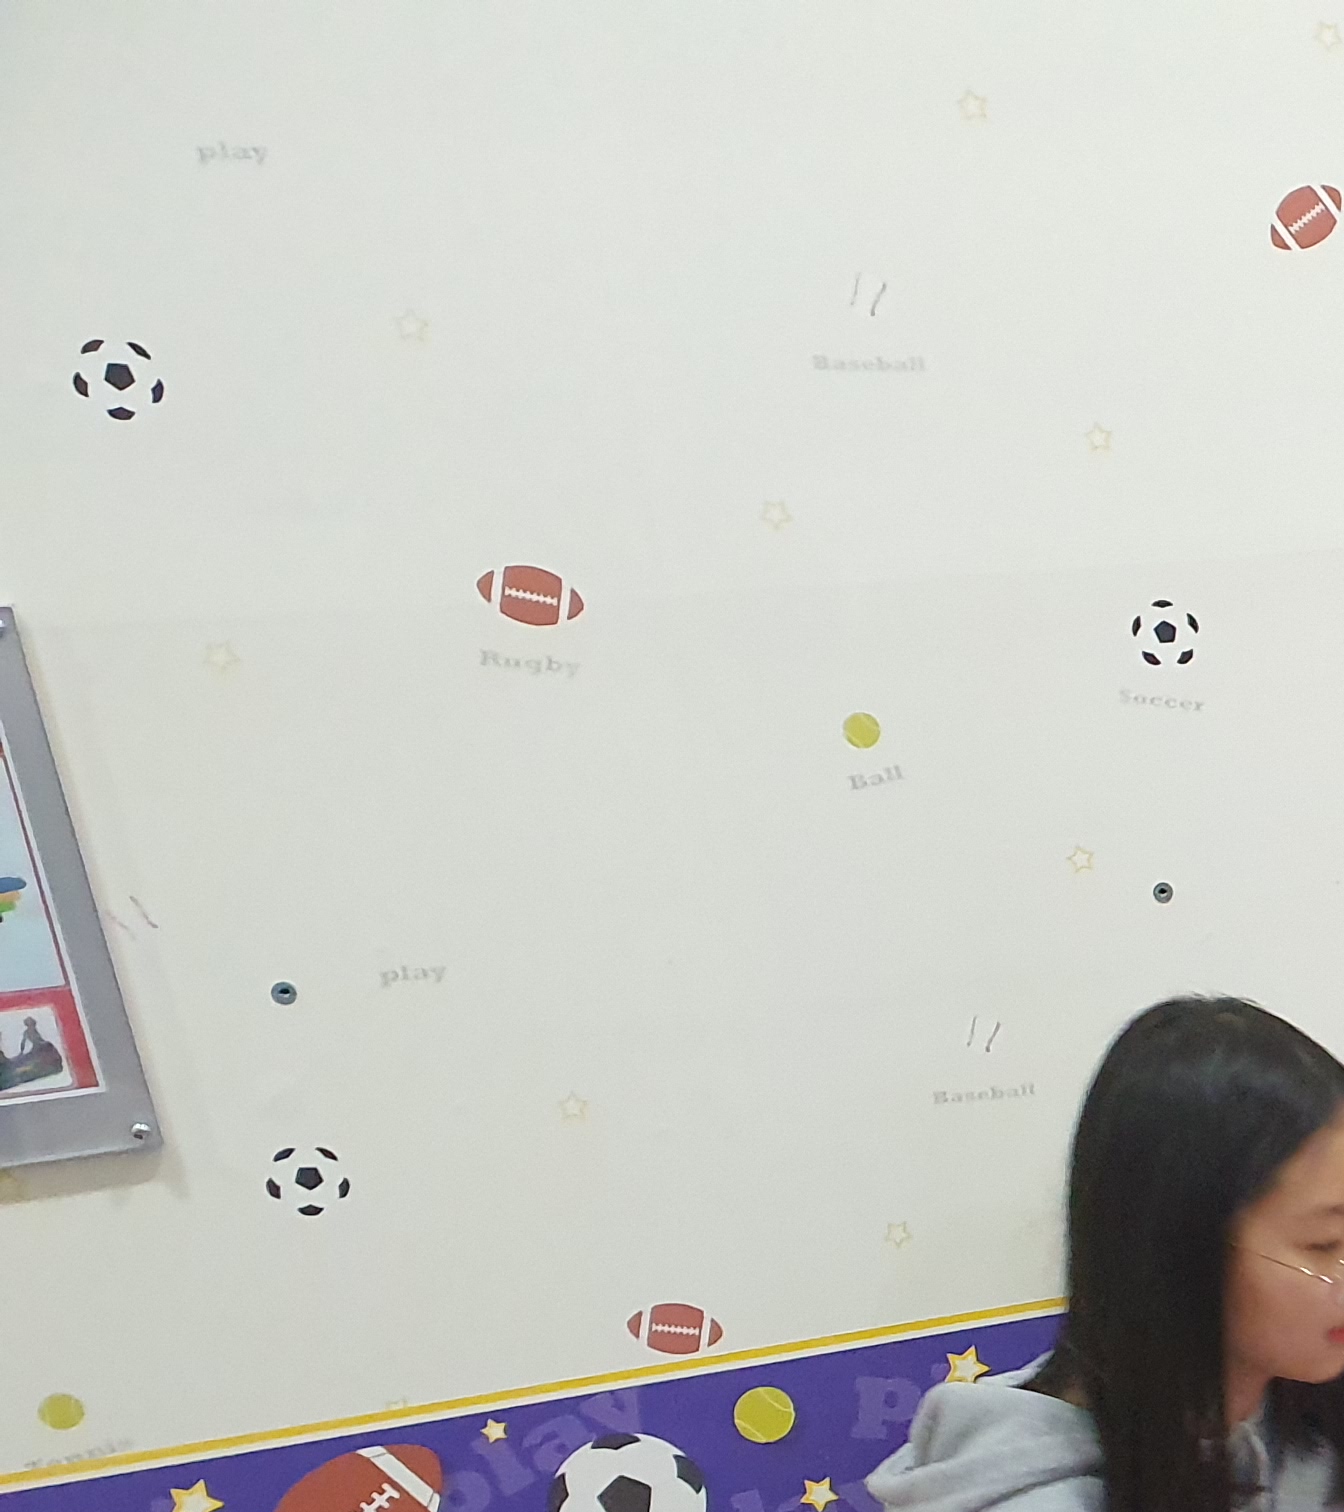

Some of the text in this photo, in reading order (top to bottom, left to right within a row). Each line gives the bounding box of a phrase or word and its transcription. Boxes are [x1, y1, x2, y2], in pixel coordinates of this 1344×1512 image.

[196, 141, 269, 166] play
[480, 649, 580, 679] Rugby
[1119, 689, 1204, 711] Soccer
[847, 765, 904, 790] Ball
[380, 965, 447, 988] play
[933, 1083, 1035, 1104] Baseball
